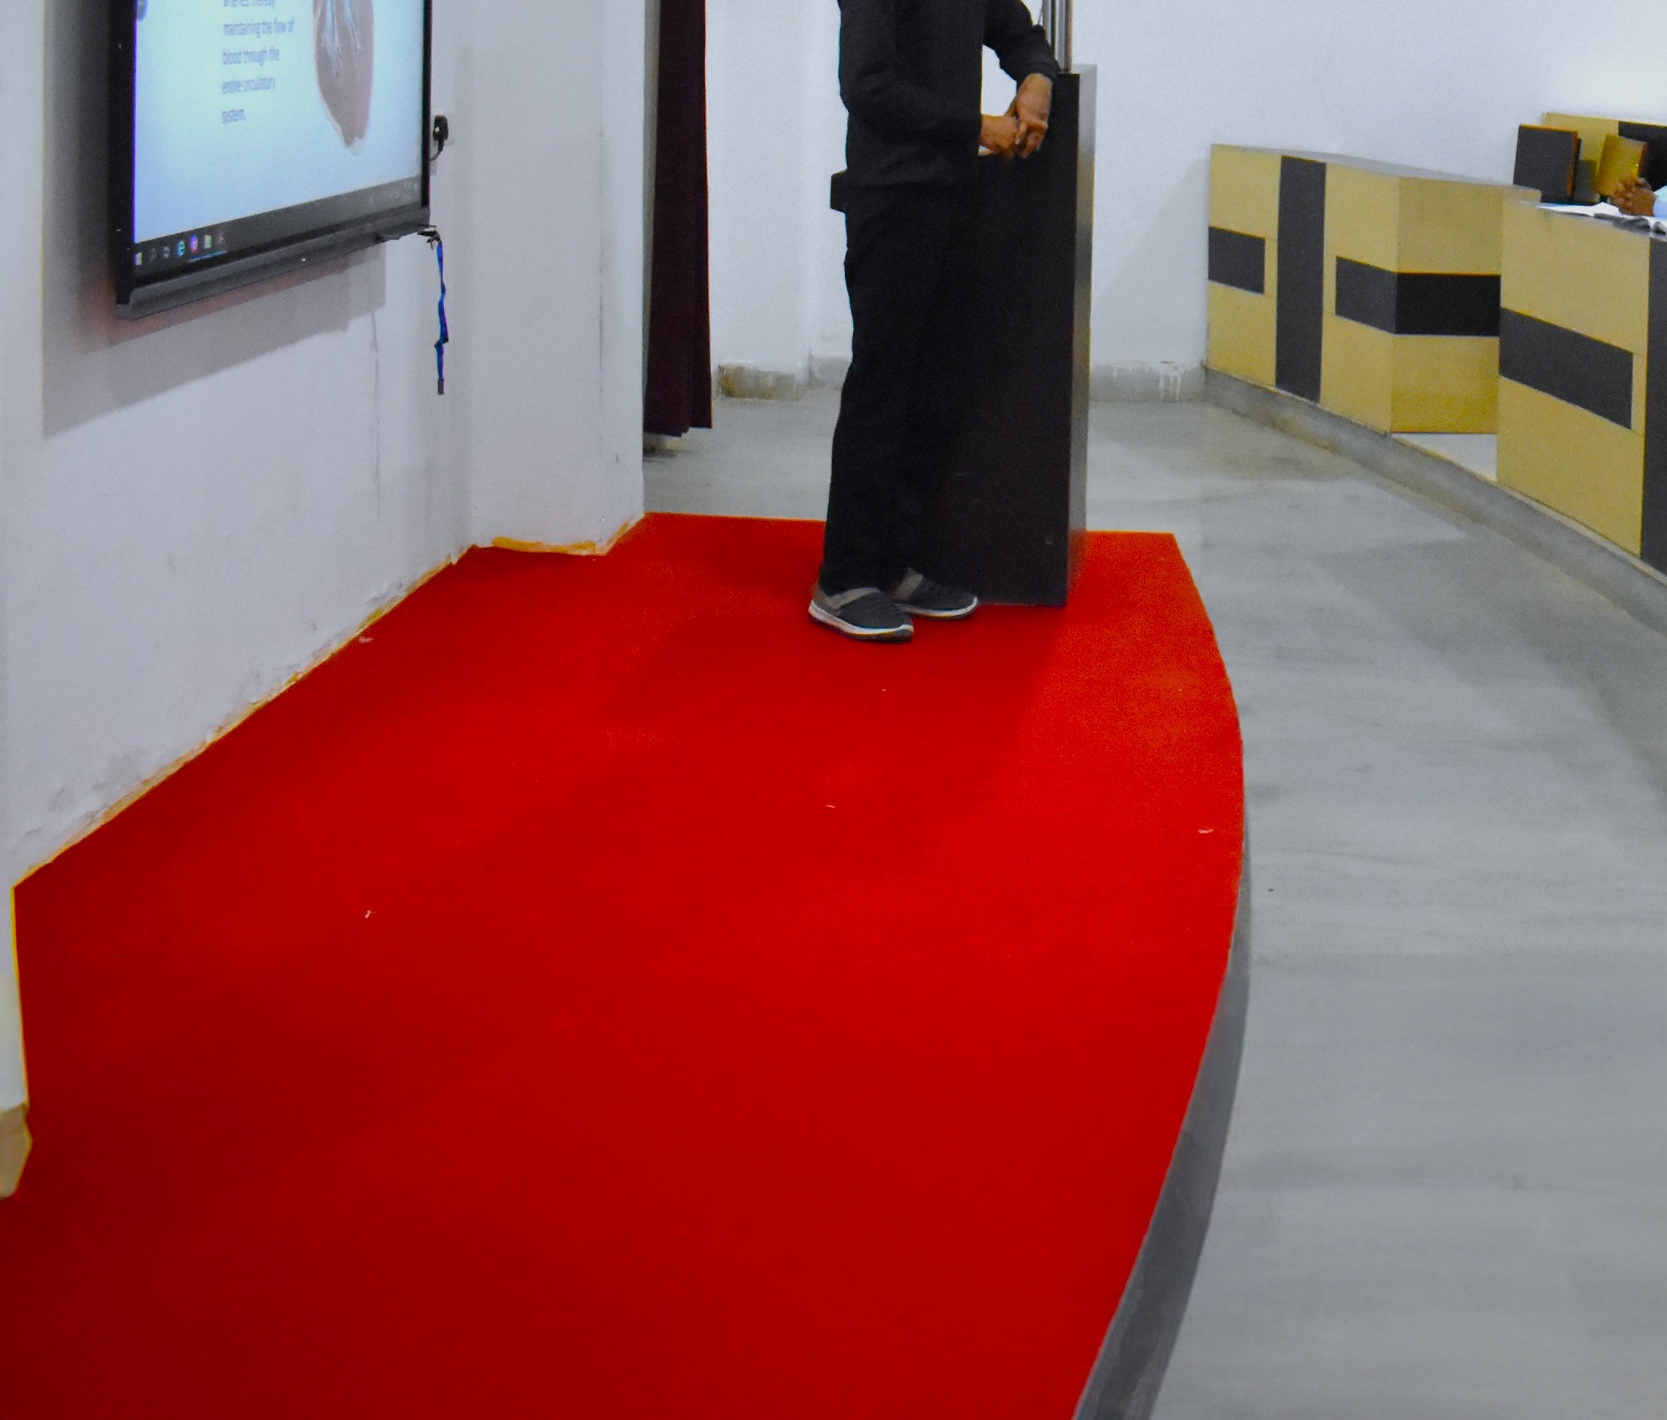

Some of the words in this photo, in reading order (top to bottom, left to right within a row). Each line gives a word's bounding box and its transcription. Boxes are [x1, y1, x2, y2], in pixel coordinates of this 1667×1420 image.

[223, 20, 261, 38] maintaining
[262, 18, 273, 34] the
[273, 17, 286, 34] flow
[223, 47, 242, 65] blood
[243, 46, 268, 66] through
[269, 45, 280, 62] the
